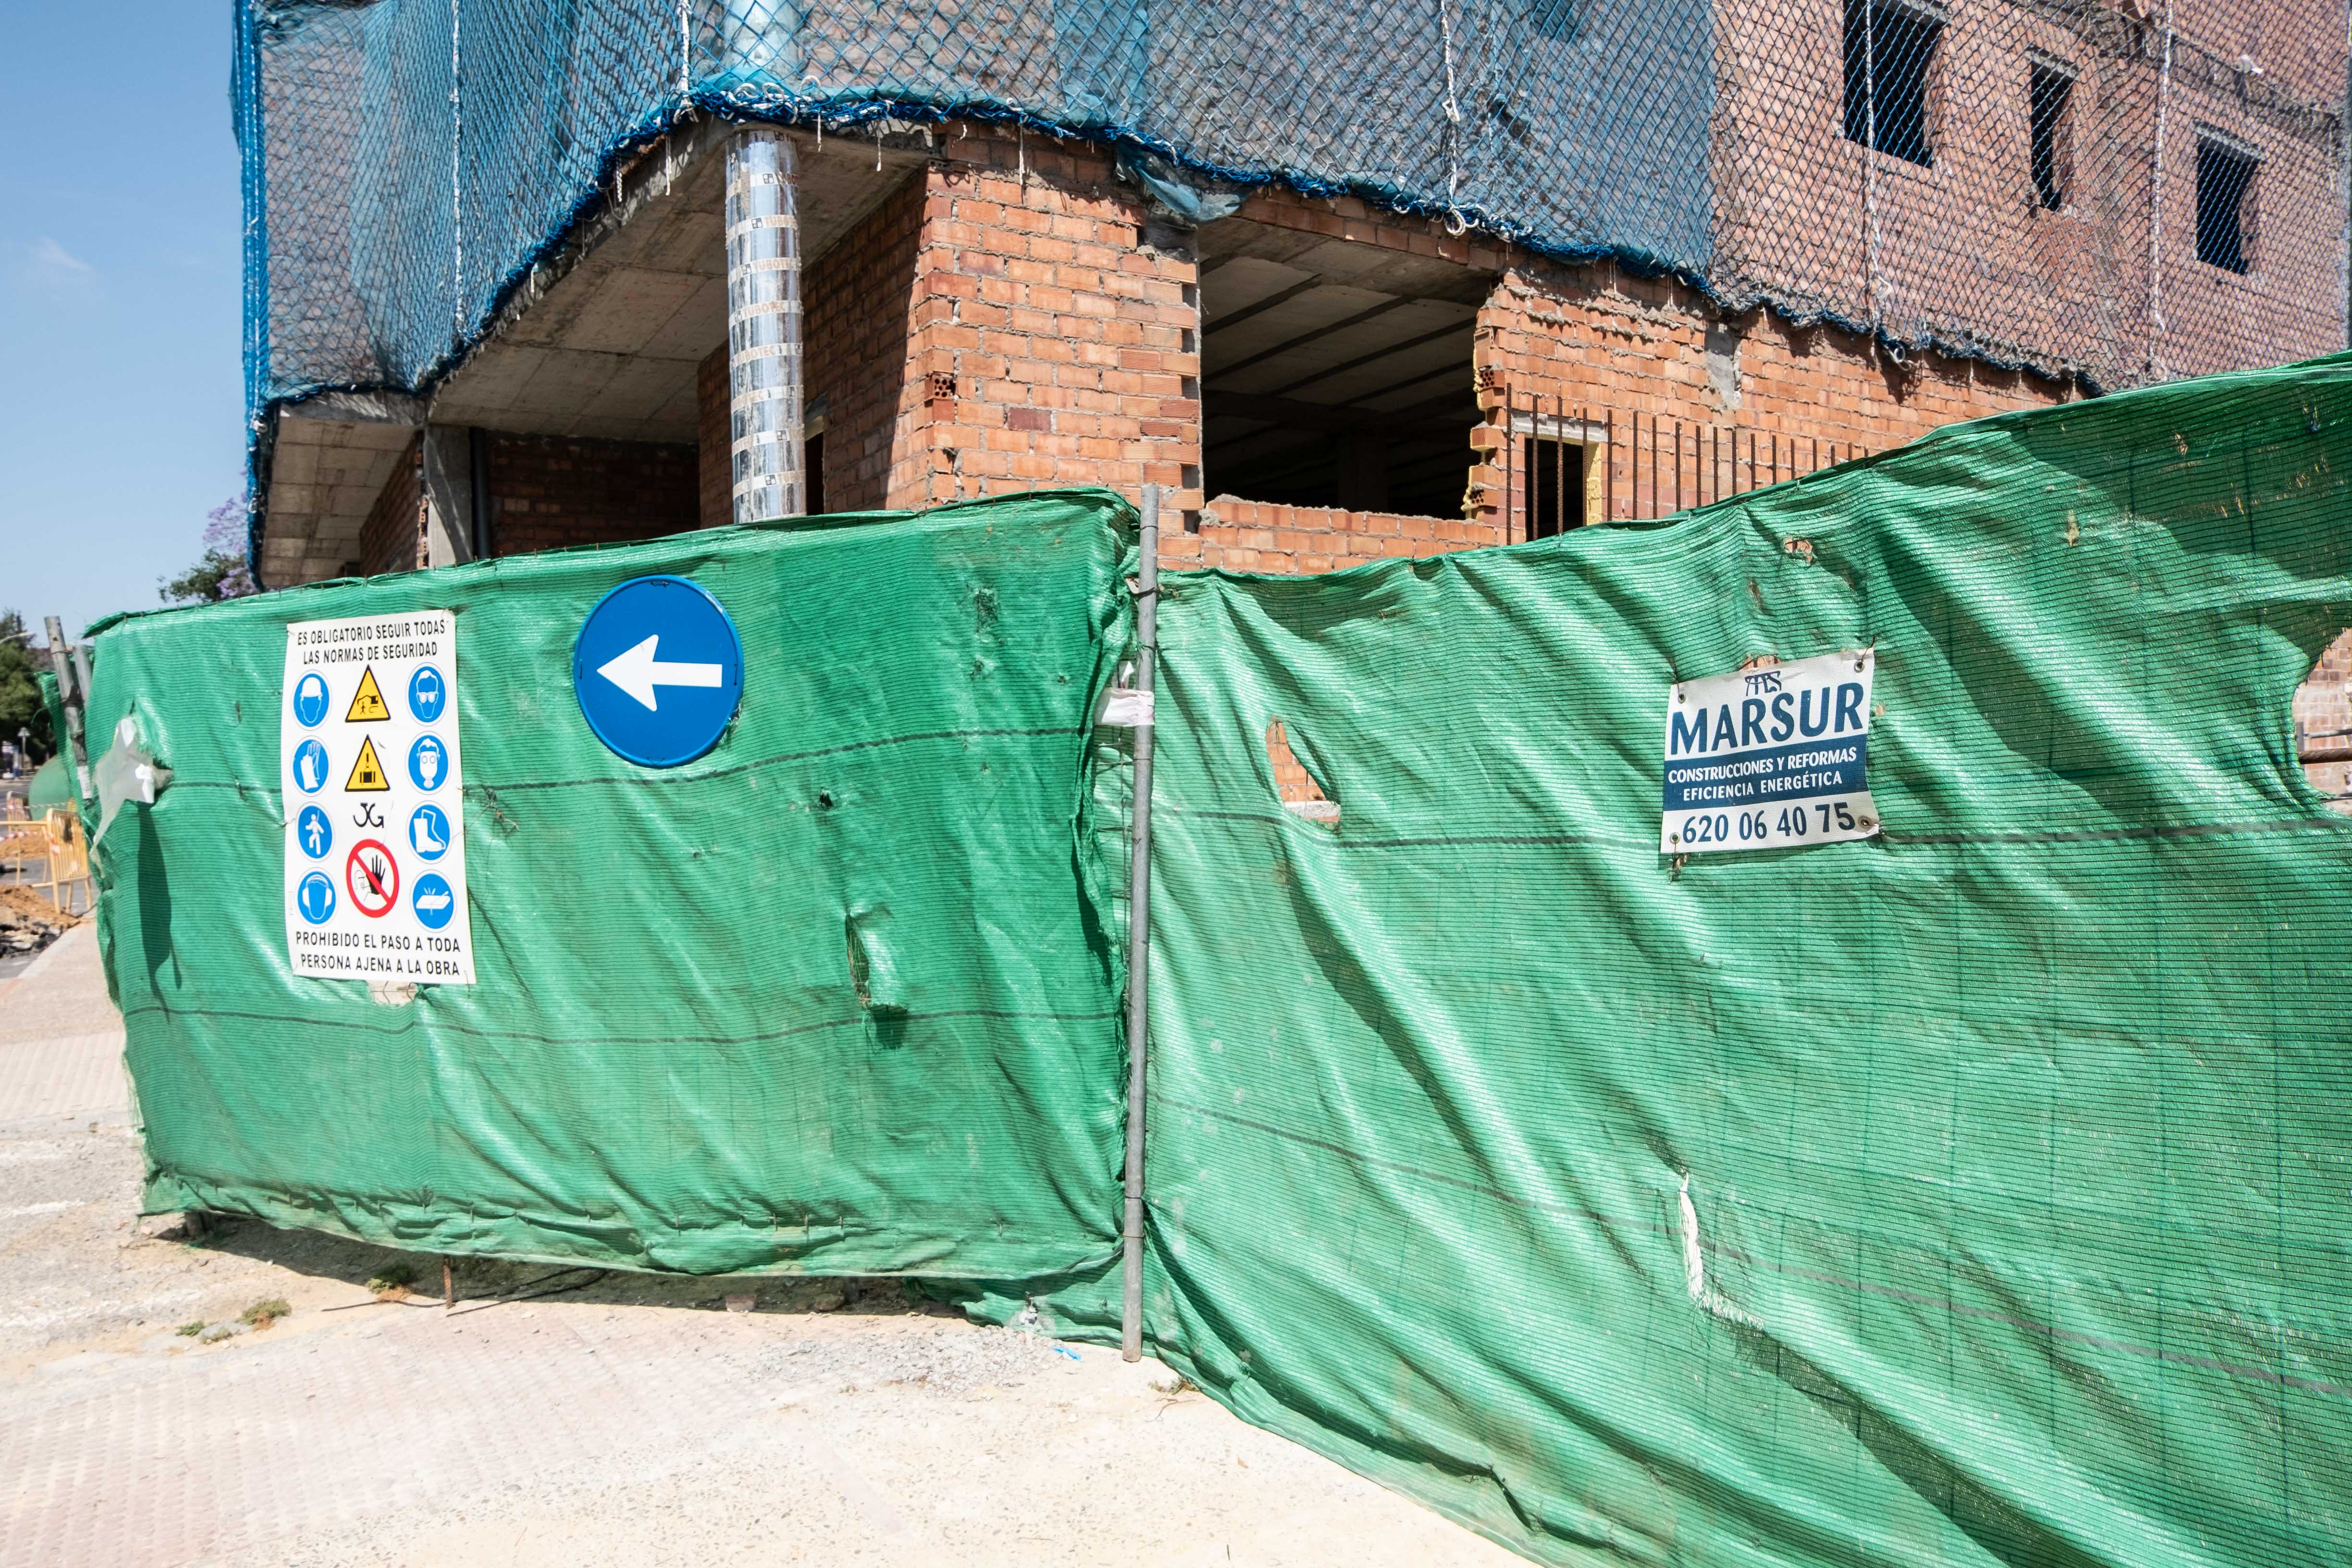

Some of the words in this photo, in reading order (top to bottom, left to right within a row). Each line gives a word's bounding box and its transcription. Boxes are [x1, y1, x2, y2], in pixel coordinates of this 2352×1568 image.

[298, 632, 307, 645] ES
[311, 626, 372, 644] OBLIGATORIO
[376, 623, 411, 639] SEGUIR
[414, 619, 444, 635] TODAS
[304, 650, 319, 664] LAS
[324, 648, 363, 662] NORMAS
[368, 646, 379, 660] DE
[383, 642, 437, 659] SEGURIDAD
[1670, 682, 1864, 756] MARSUR
[1668, 758, 1774, 784] CONSTRUCCIONES
[1777, 757, 1784, 771] Y
[1788, 747, 1856, 769] REFORMAS
[1683, 785, 1754, 801] EFICIENCIA
[1761, 771, 1842, 794] ENERGÉTICA
[1683, 815, 1728, 843] 620
[1740, 810, 1767, 840] 06
[1777, 807, 1806, 836] 40
[1815, 802, 1855, 833] 75
[296, 931, 359, 947] PROHIBIDO
[365, 934, 377, 948] EL
[381, 935, 410, 950] PASO
[416, 937, 423, 950] A
[427, 938, 460, 952] TODA
[301, 954, 350, 969] PERSONA
[356, 957, 392, 971] AJENA
[397, 959, 403, 972] A
[408, 960, 421, 973] LA
[427, 961, 459, 975] OBRA
